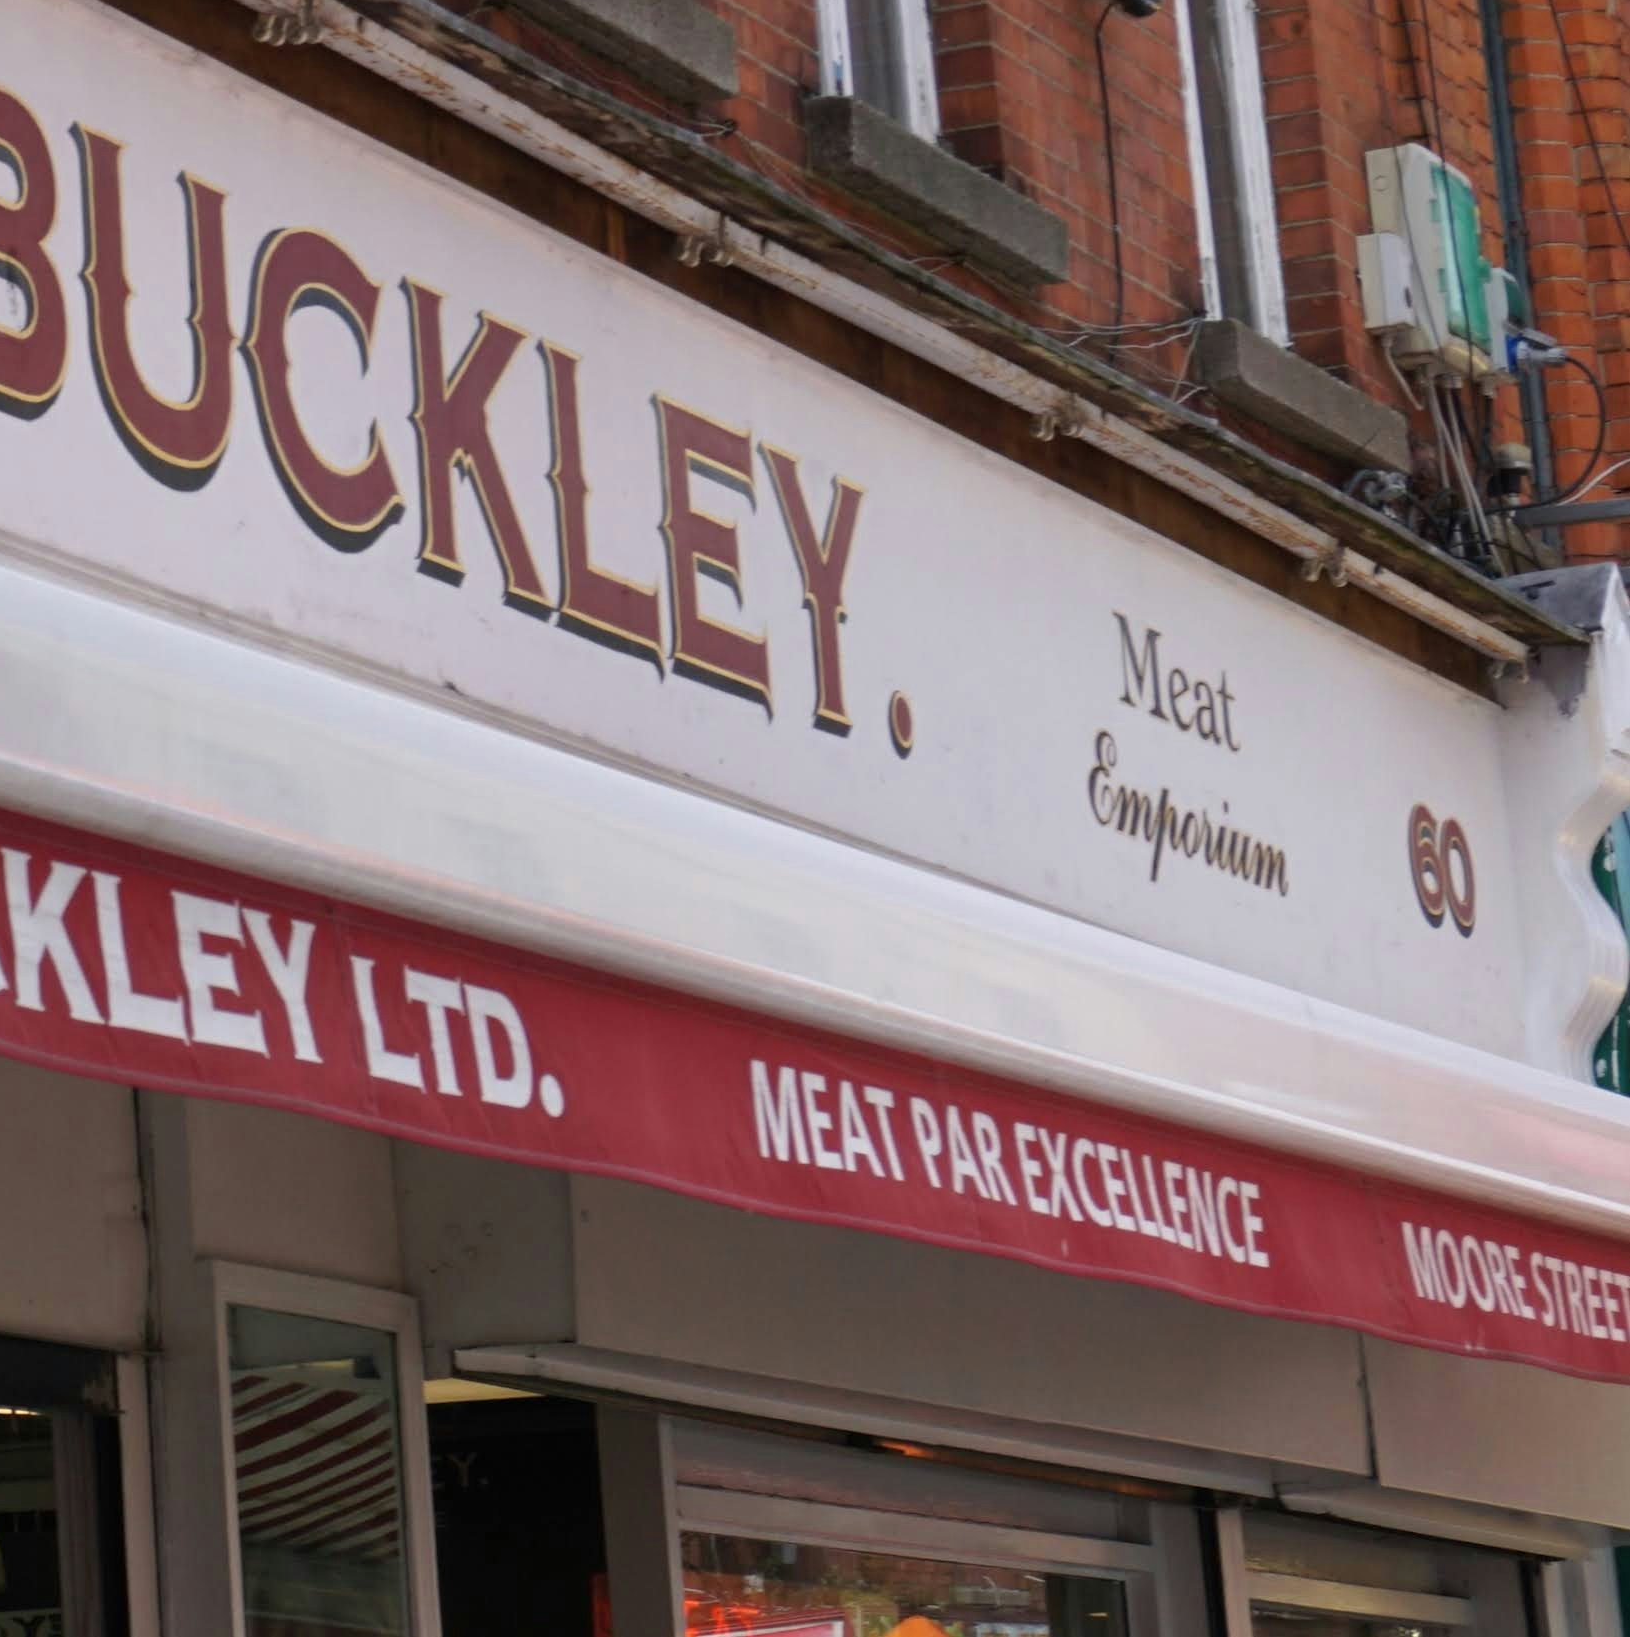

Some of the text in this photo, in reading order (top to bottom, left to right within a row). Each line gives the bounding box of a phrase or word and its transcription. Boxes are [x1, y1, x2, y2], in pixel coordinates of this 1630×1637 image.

[1111, 609, 1241, 752] Meat
[1087, 730, 1289, 897] Emporium
[1408, 803, 1477, 939] 60
[348, 955, 566, 1119] LTD.
[749, 1058, 1271, 1268] MEAT PAR EXCELLENCE
[1400, 1220, 1630, 1342] MOORE STREET
